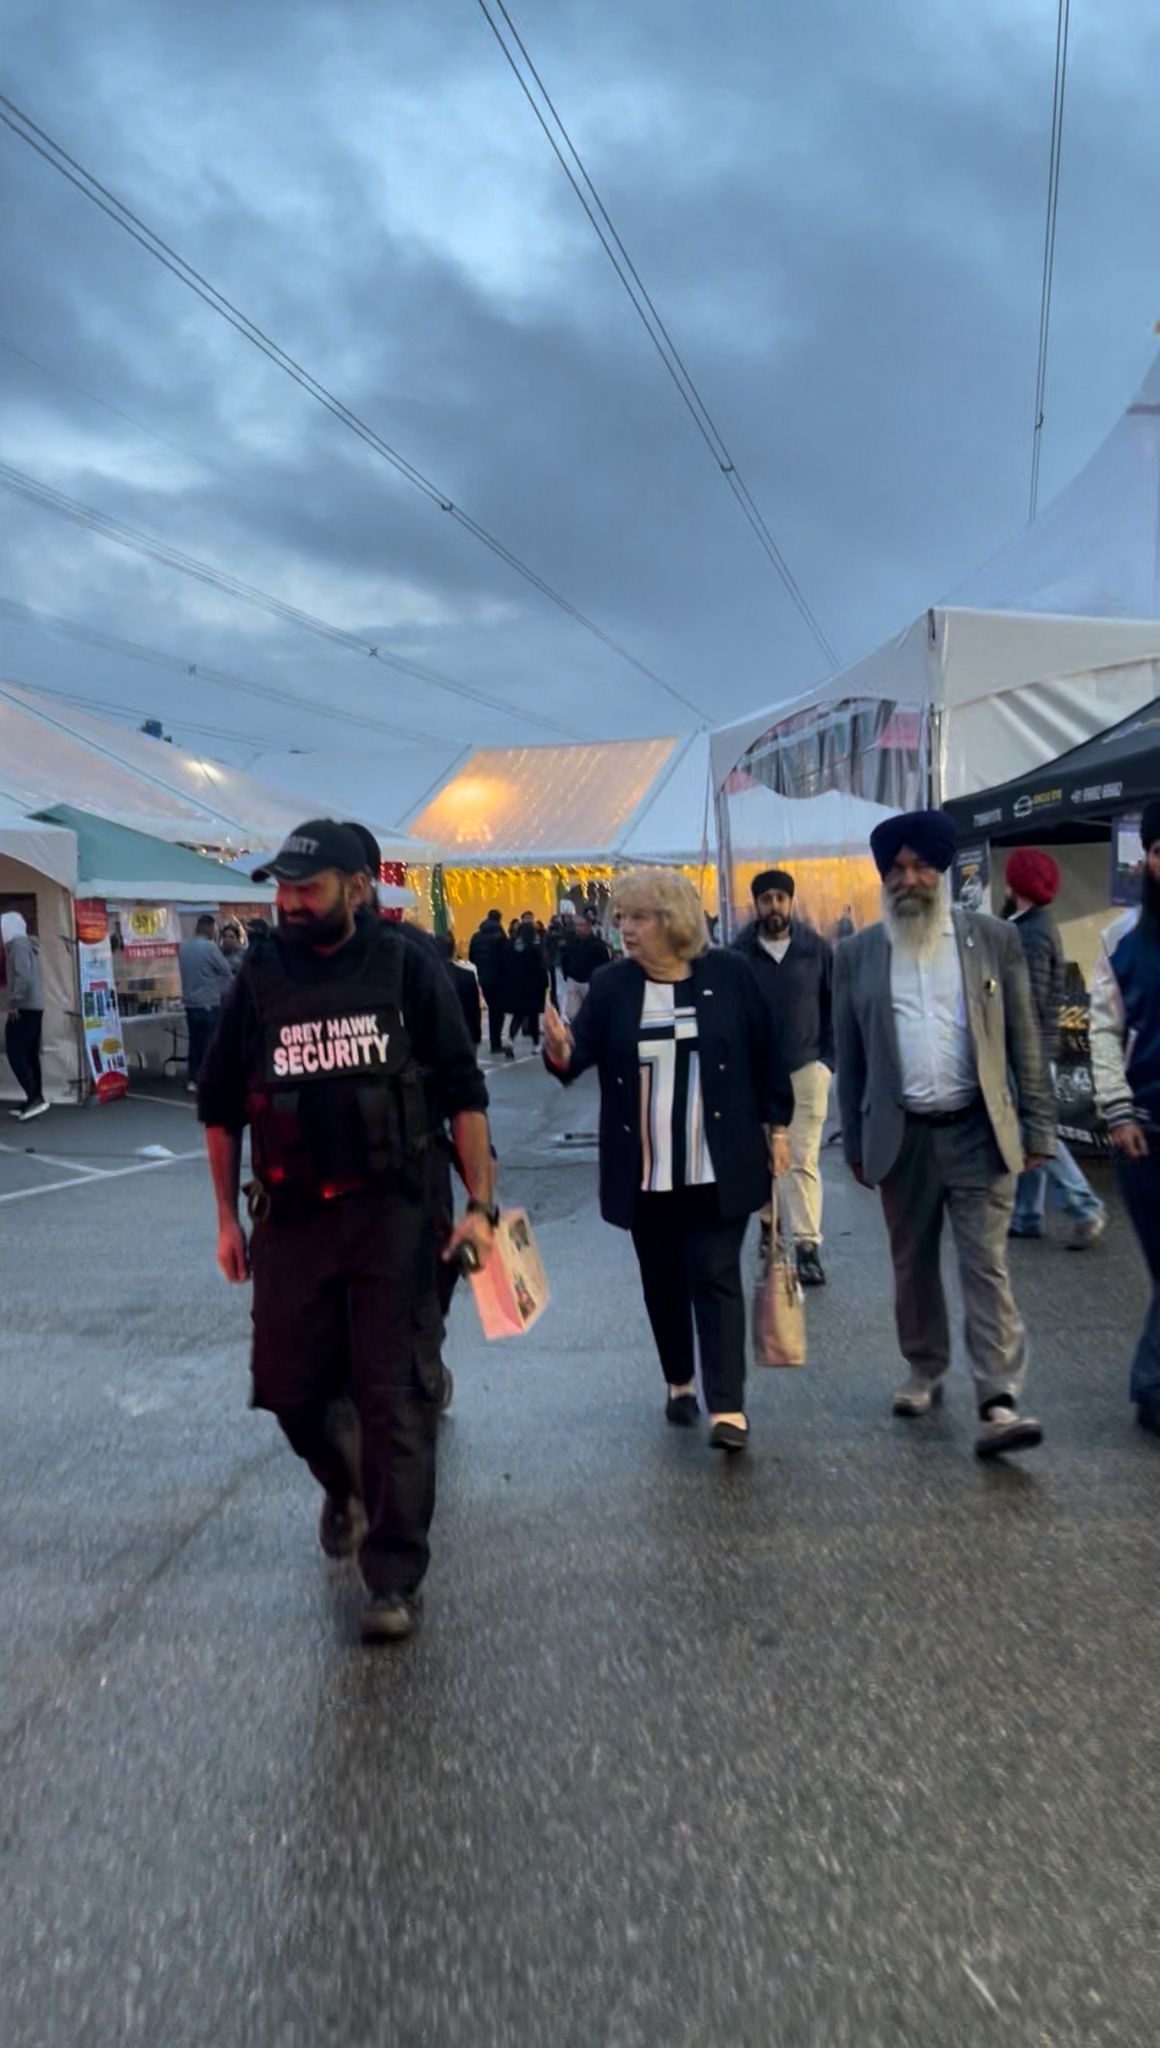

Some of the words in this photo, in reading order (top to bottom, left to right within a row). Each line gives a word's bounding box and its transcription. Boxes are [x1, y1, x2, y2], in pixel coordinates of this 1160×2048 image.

[280, 1021, 323, 1046] GREY
[326, 1014, 379, 1038] HAWK
[273, 1033, 390, 1076] SECURITY
